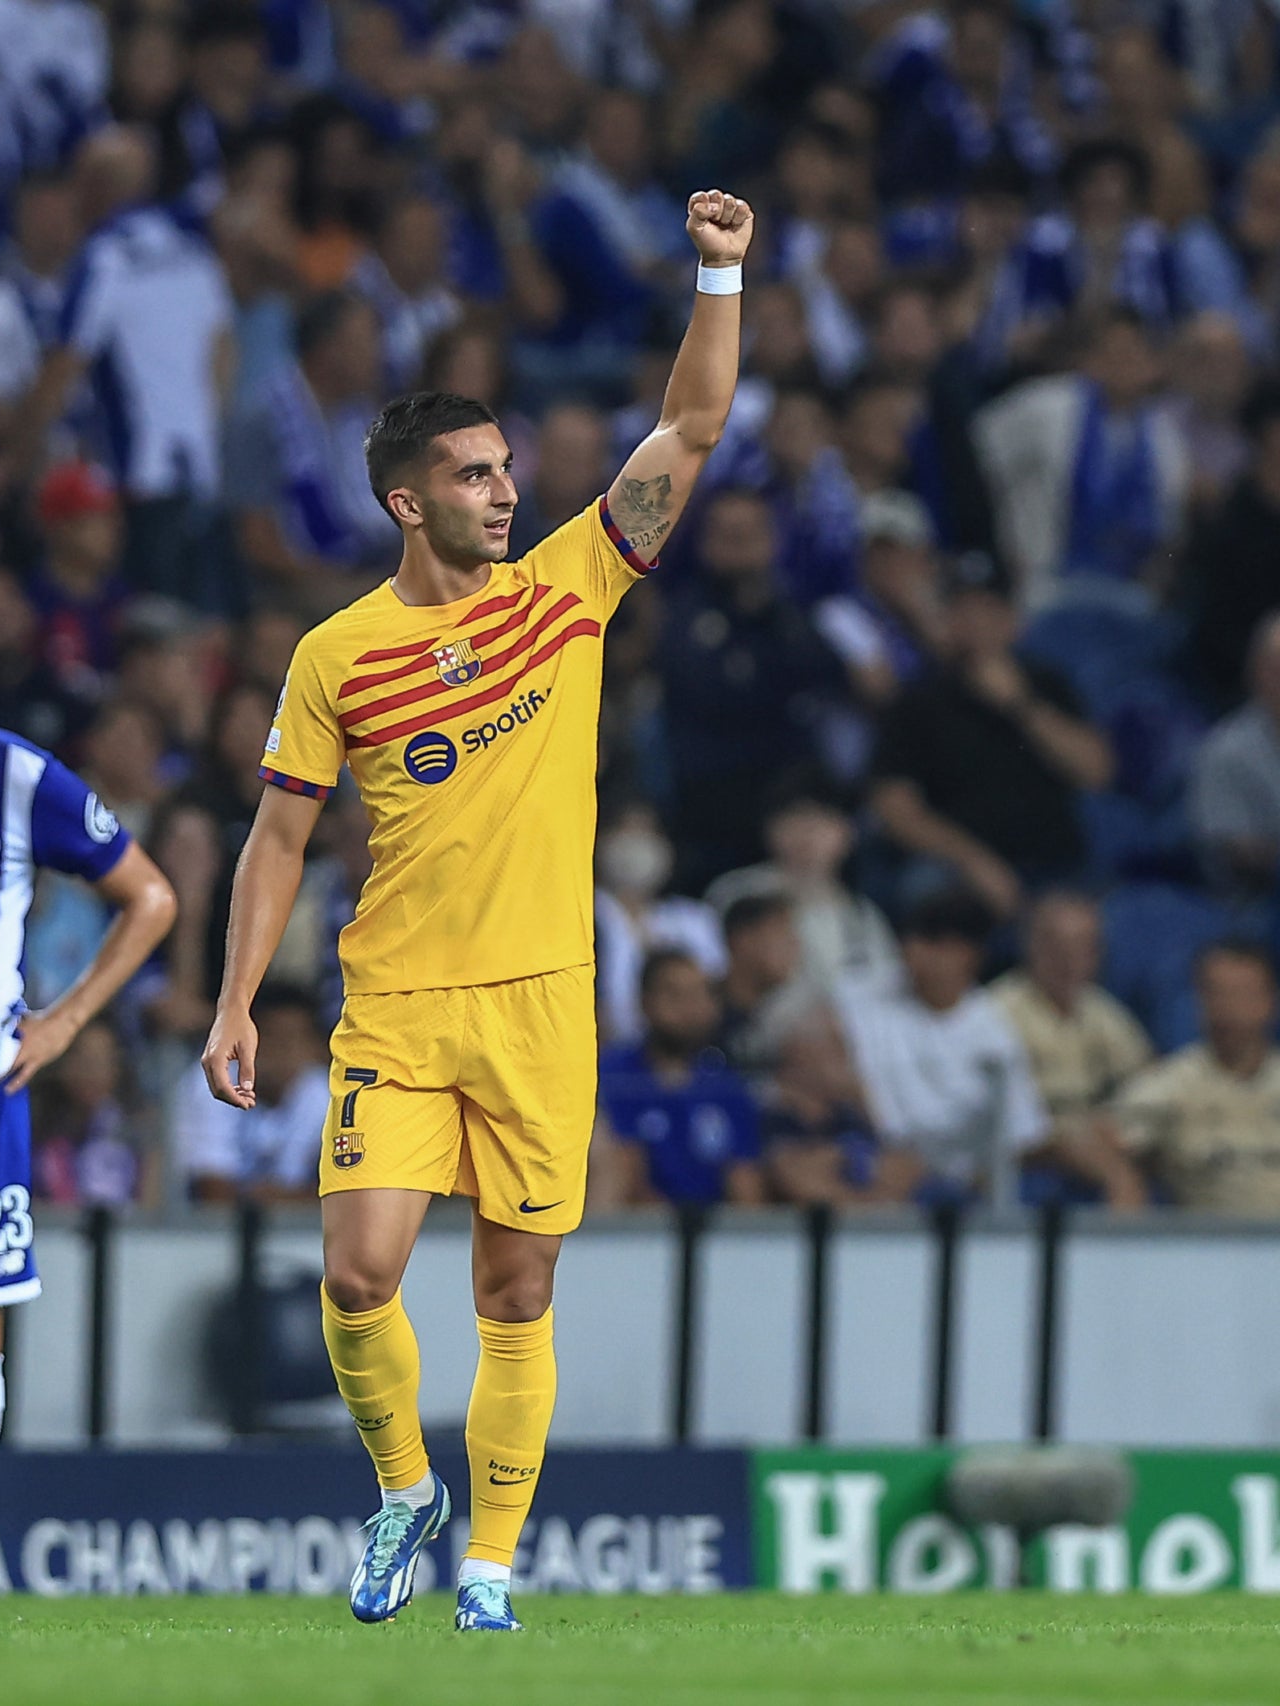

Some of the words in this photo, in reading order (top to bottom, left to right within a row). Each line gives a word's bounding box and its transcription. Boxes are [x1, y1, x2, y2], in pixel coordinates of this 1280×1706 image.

[340, 1067, 379, 1128] 7
[488, 1459, 537, 1478] barça
[450, 1514, 725, 1594] LAGUE
